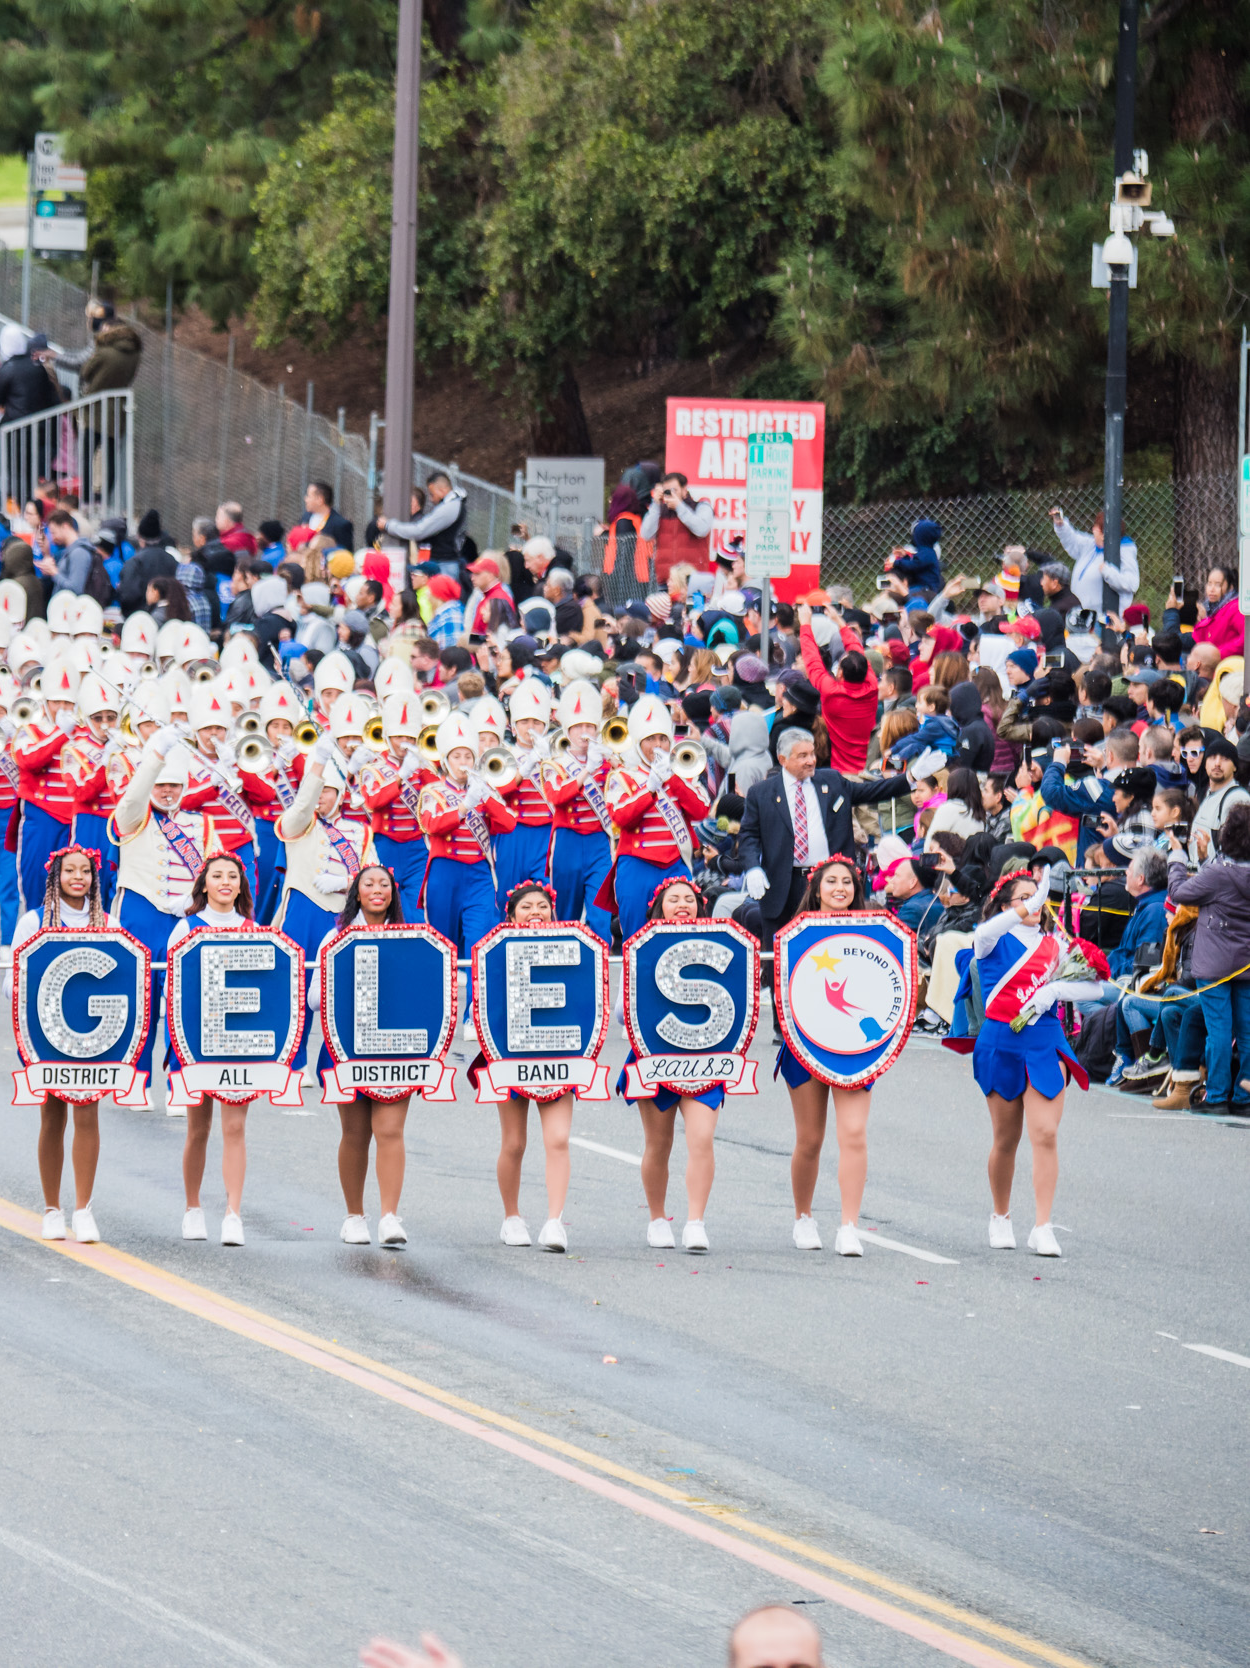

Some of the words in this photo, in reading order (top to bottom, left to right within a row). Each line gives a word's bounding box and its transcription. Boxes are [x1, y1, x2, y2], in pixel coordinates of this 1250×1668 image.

[675, 407, 816, 440] RESTRICTED
[756, 432, 784, 443] END
[698, 440, 747, 480] AR
[766, 449, 789, 463] HOUR
[536, 471, 586, 485] Norton
[751, 467, 788, 480] PARKING
[536, 505, 596, 525] Mseu
[759, 526, 778, 534] PAY
[755, 544, 781, 552] PARK
[466, 810, 491, 853] NGELES
[657, 798, 688, 844] ANGELES
[173, 838, 203, 878] ANGEL
[336, 843, 360, 875] ANGE
[843, 947, 889, 969] BEYOND
[888, 969, 902, 993] THE
[36, 946, 129, 1059] G
[200, 945, 276, 1056] E
[353, 944, 428, 1055] L
[505, 940, 582, 1052] E
[654, 938, 736, 1050] S
[885, 997, 902, 1022] BELL
[42, 1067, 120, 1085] DISTRICT
[218, 1068, 253, 1086] ALL
[351, 1064, 430, 1082] DISTRICT
[517, 1063, 569, 1082] BAND
[646, 1057, 734, 1079] LAUSD
